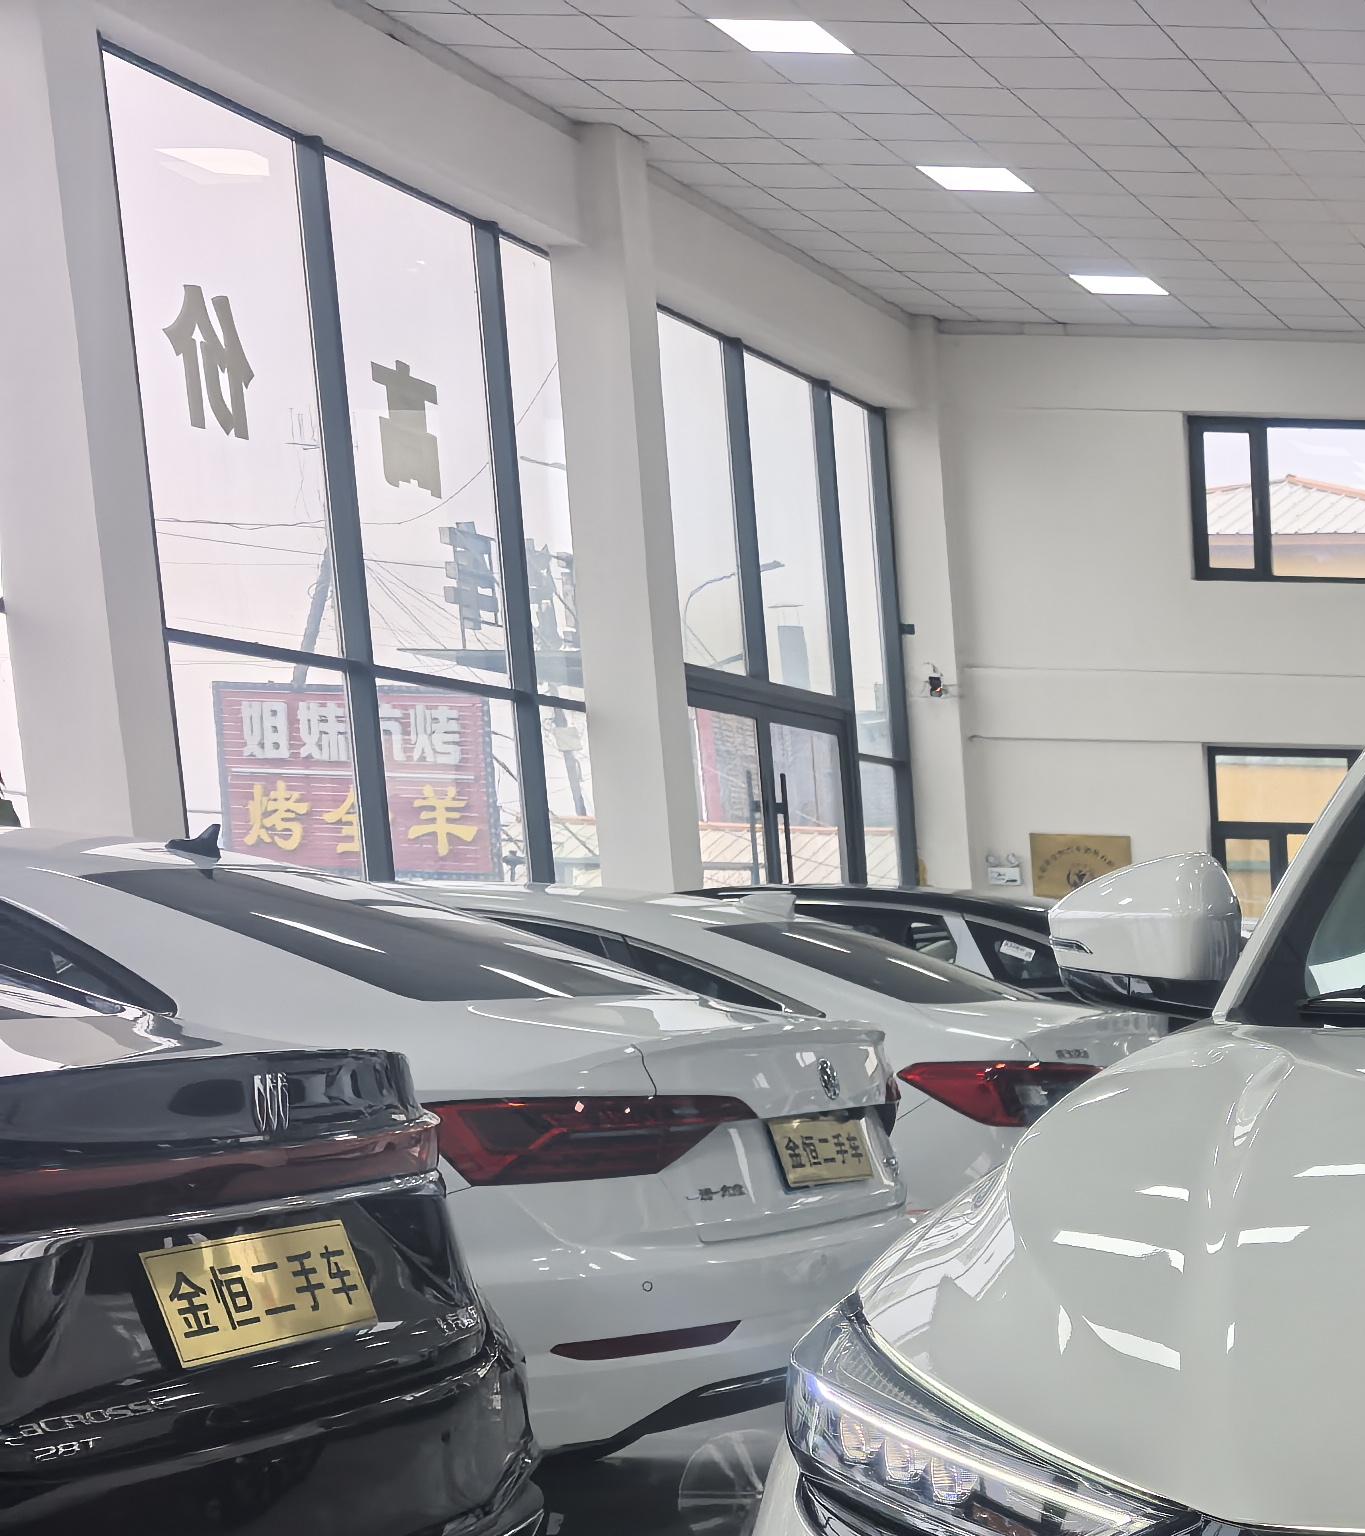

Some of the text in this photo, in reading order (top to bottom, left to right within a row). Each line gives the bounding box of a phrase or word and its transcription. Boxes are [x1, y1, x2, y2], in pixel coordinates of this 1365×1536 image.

[785, 1134, 864, 1168] 金恒二手车
[169, 1245, 358, 1338] 金恒二手车
